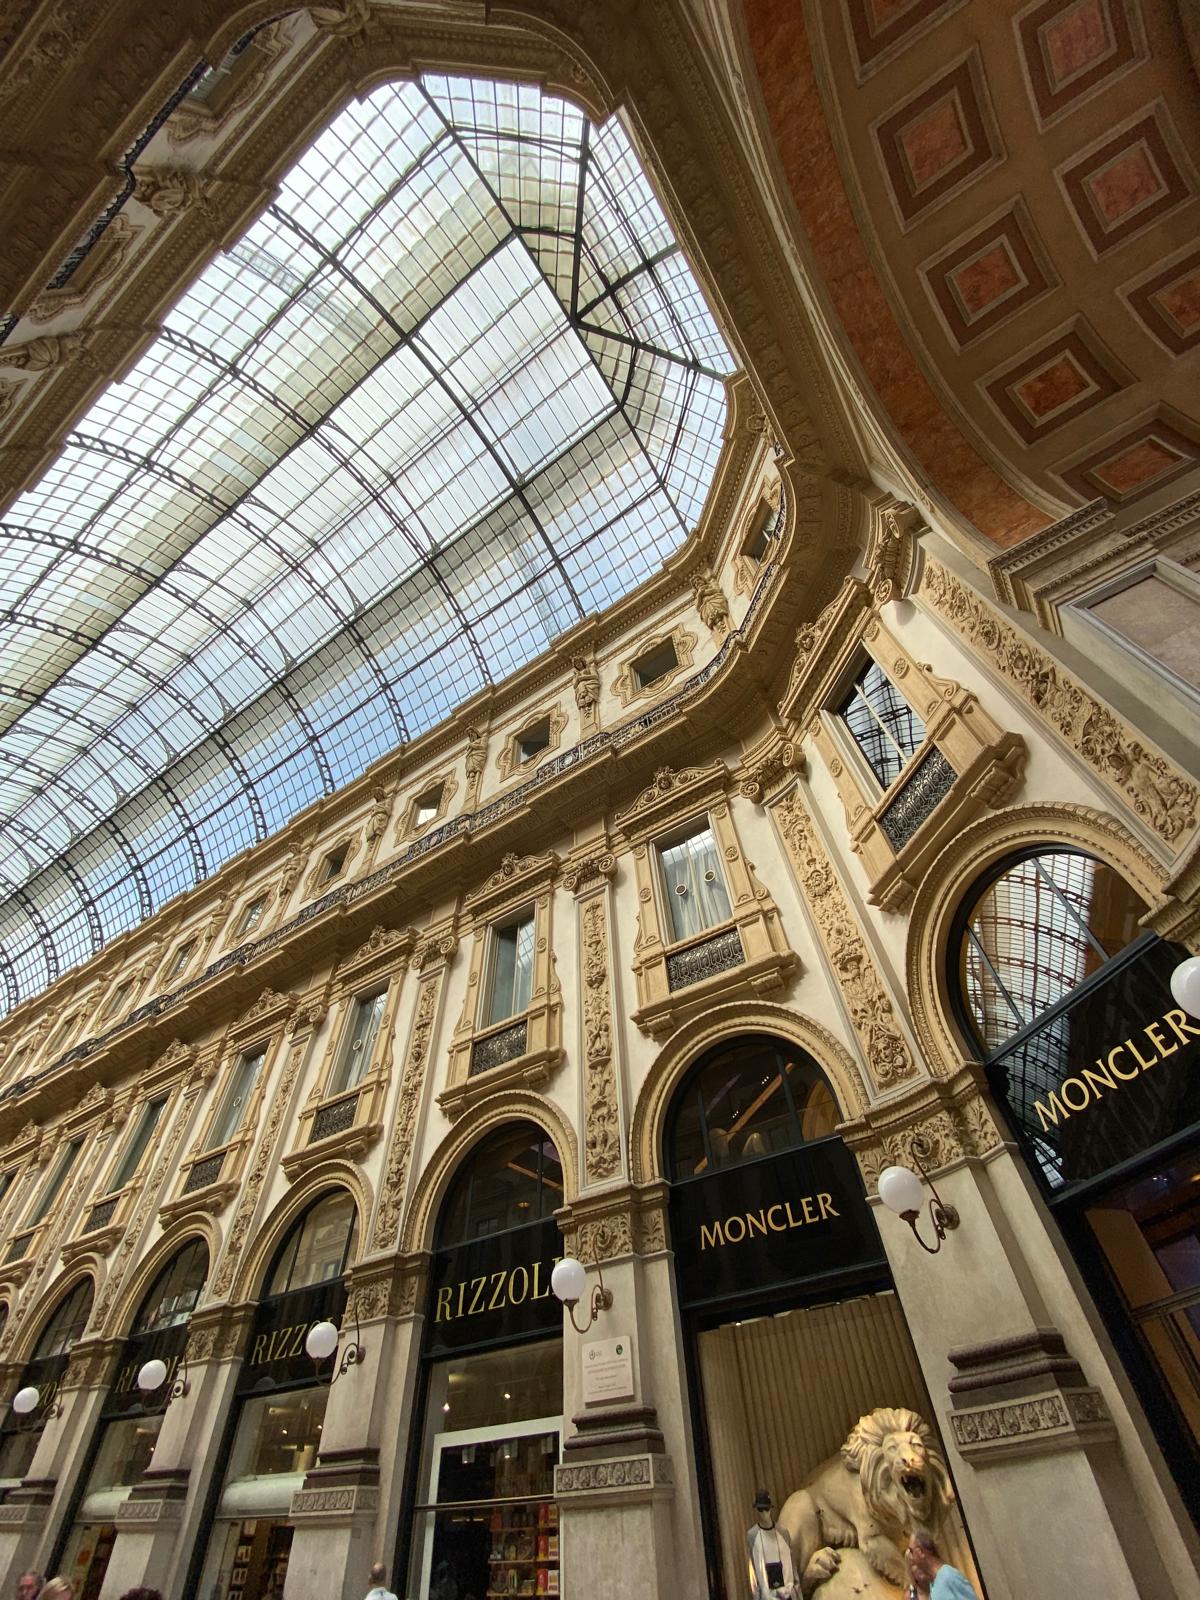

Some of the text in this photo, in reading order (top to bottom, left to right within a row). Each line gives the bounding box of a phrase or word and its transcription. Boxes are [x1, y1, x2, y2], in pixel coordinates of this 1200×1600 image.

[1033, 1009, 1200, 1133] MONCLER
[700, 1192, 840, 1250] MONCLER
[433, 1256, 563, 1323] RIZZOL
